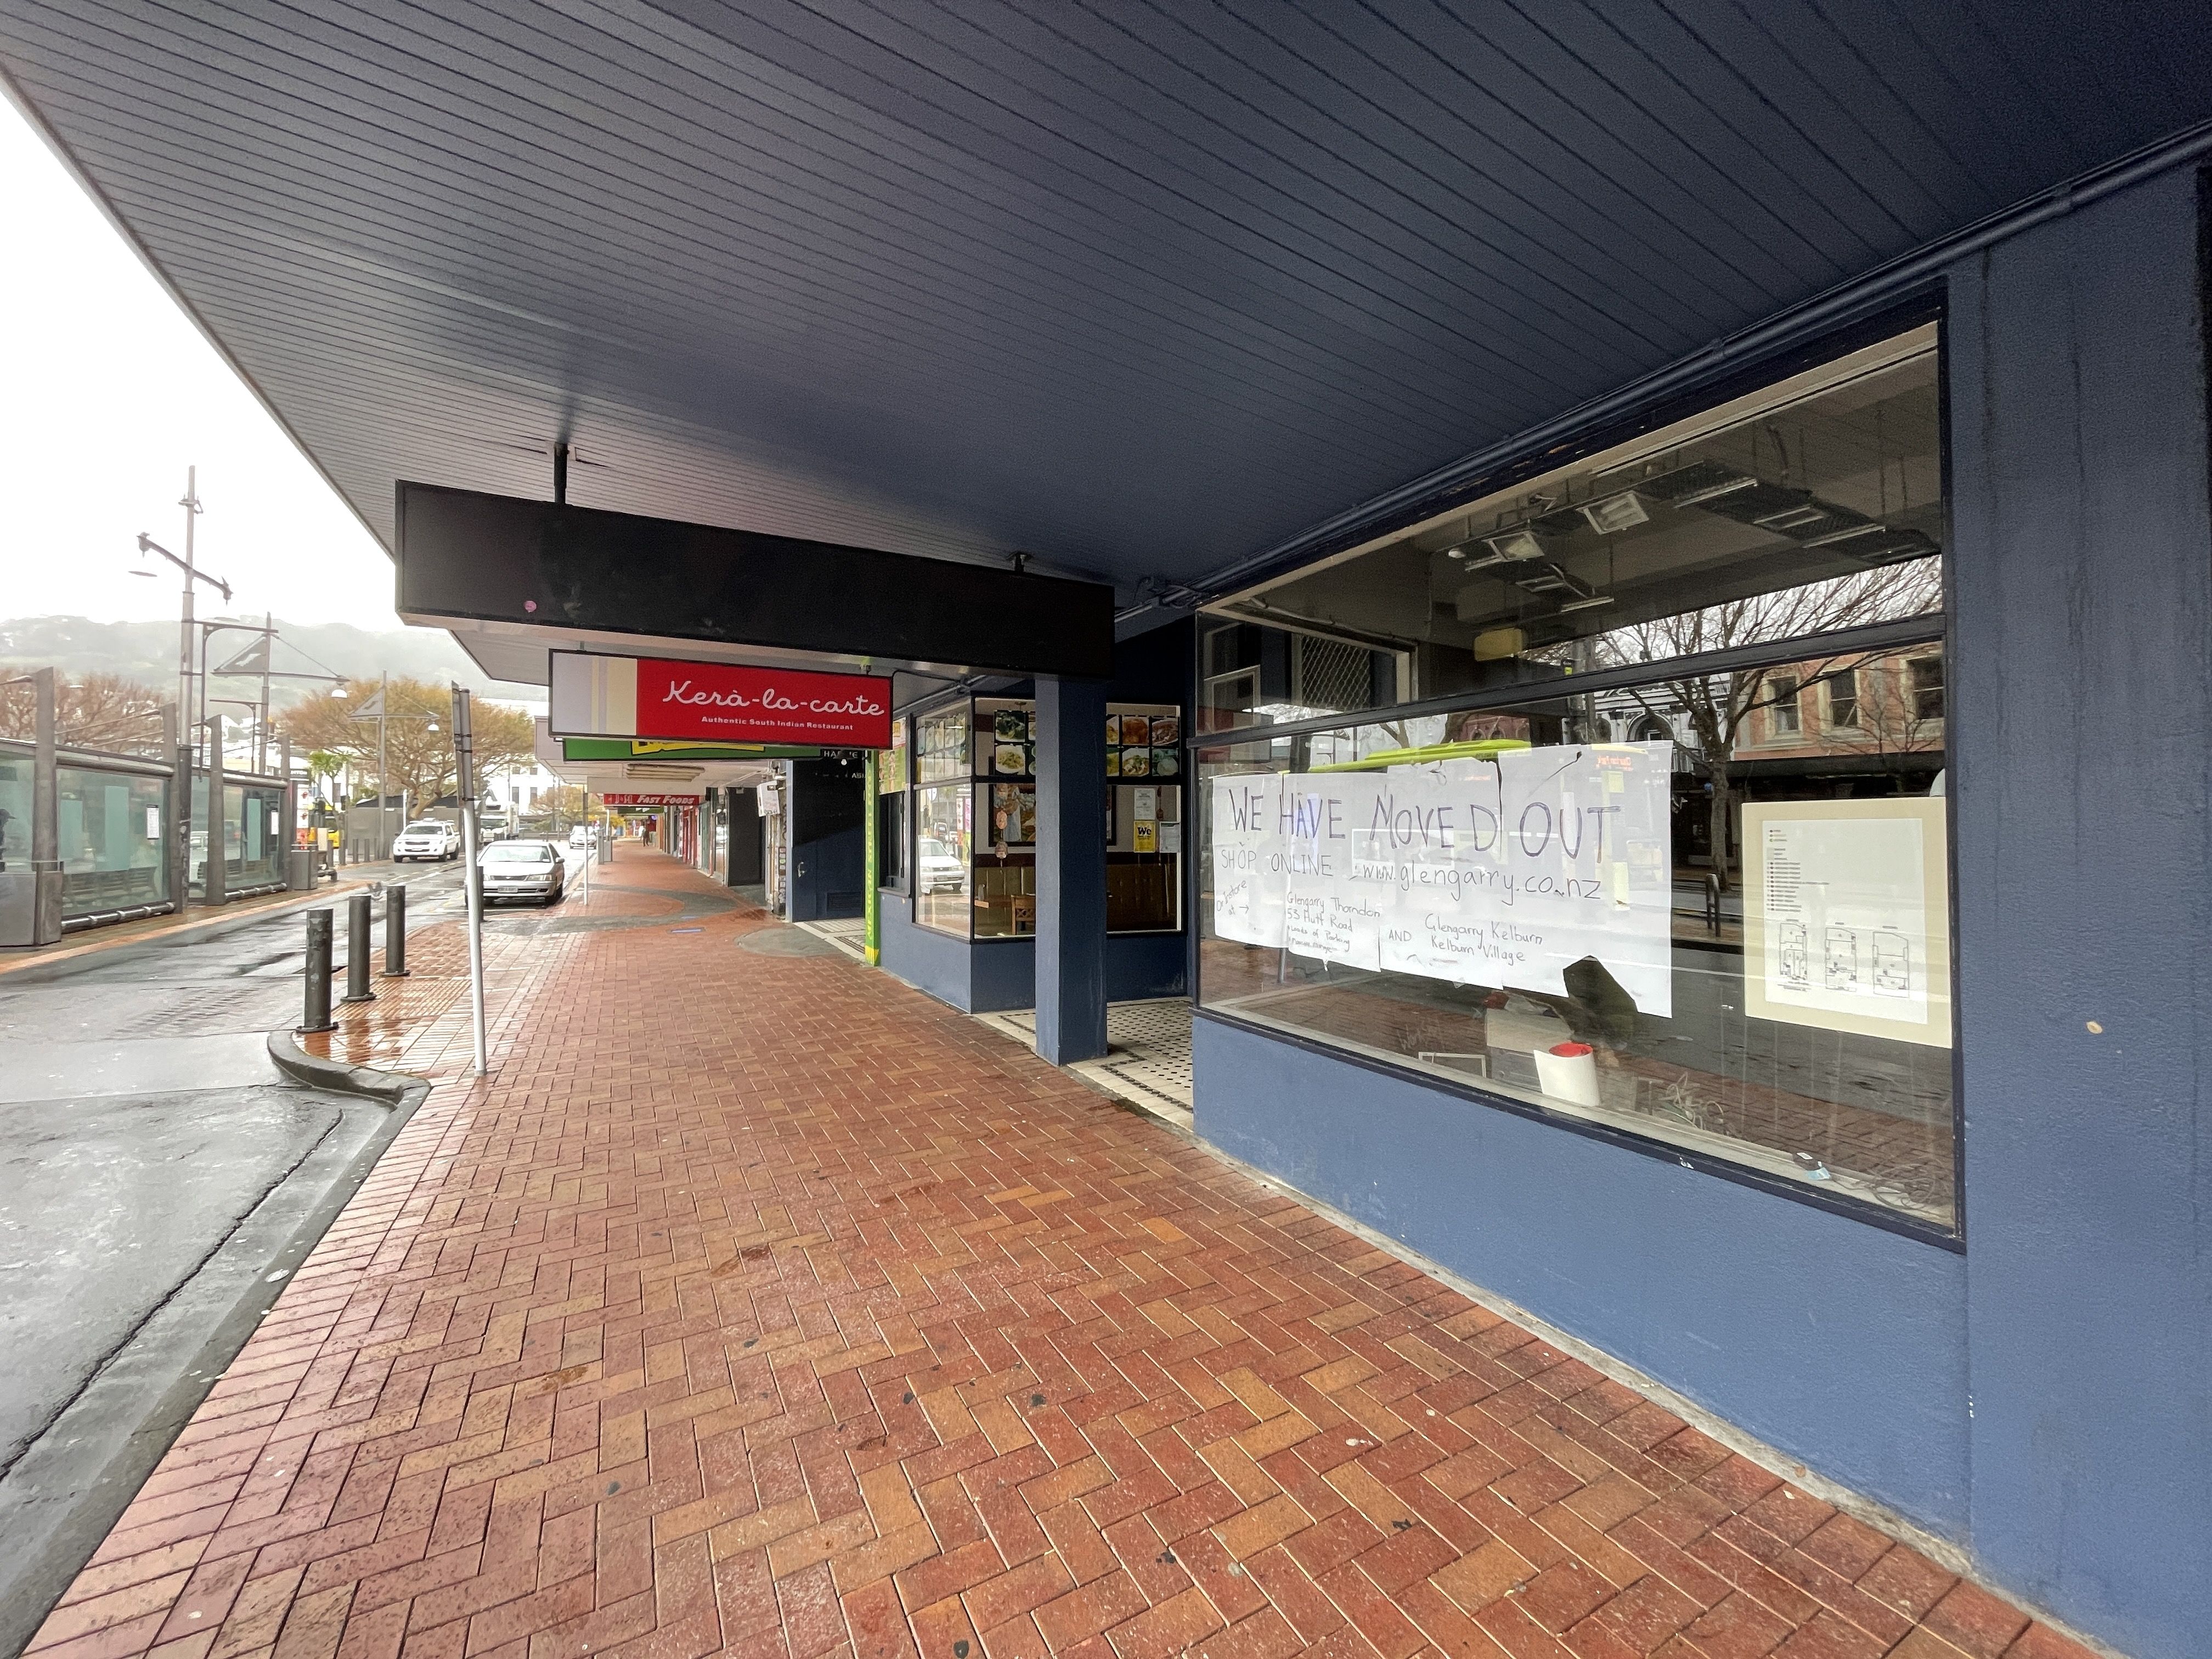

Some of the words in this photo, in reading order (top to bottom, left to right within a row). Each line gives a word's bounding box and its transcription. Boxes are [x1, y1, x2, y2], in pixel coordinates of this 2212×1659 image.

[662, 680, 884, 716] Kerà-la-carte
[702, 716, 747, 725] Authentic
[749, 718, 775, 726] South
[777, 719, 804, 727] Indian
[807, 722, 853, 730] Restaurant
[637, 795, 662, 804] FAST
[663, 795, 695, 804] FOODS
[1228, 786, 1263, 832] WE
[1279, 793, 1346, 839] HAVE
[1519, 802, 1621, 864] OUT
[1221, 849, 1256, 870] SHOP
[1271, 853, 1334, 876] ONLINE
[1228, 905, 1235, 915] at
[1287, 892, 1324, 913] Glengarry
[1330, 898, 1380, 917] Thorndon
[1287, 908, 1300, 919] 53
[1304, 909, 1324, 926] Hutt
[1330, 914, 1353, 932] Road
[1425, 913, 1483, 949] Glengarry
[1491, 921, 1543, 945] Kelburn
[1313, 929, 1318, 938] of
[1389, 929, 1412, 941] AND
[1431, 935, 1474, 956] Kelburn
[1483, 945, 1526, 966] Village
